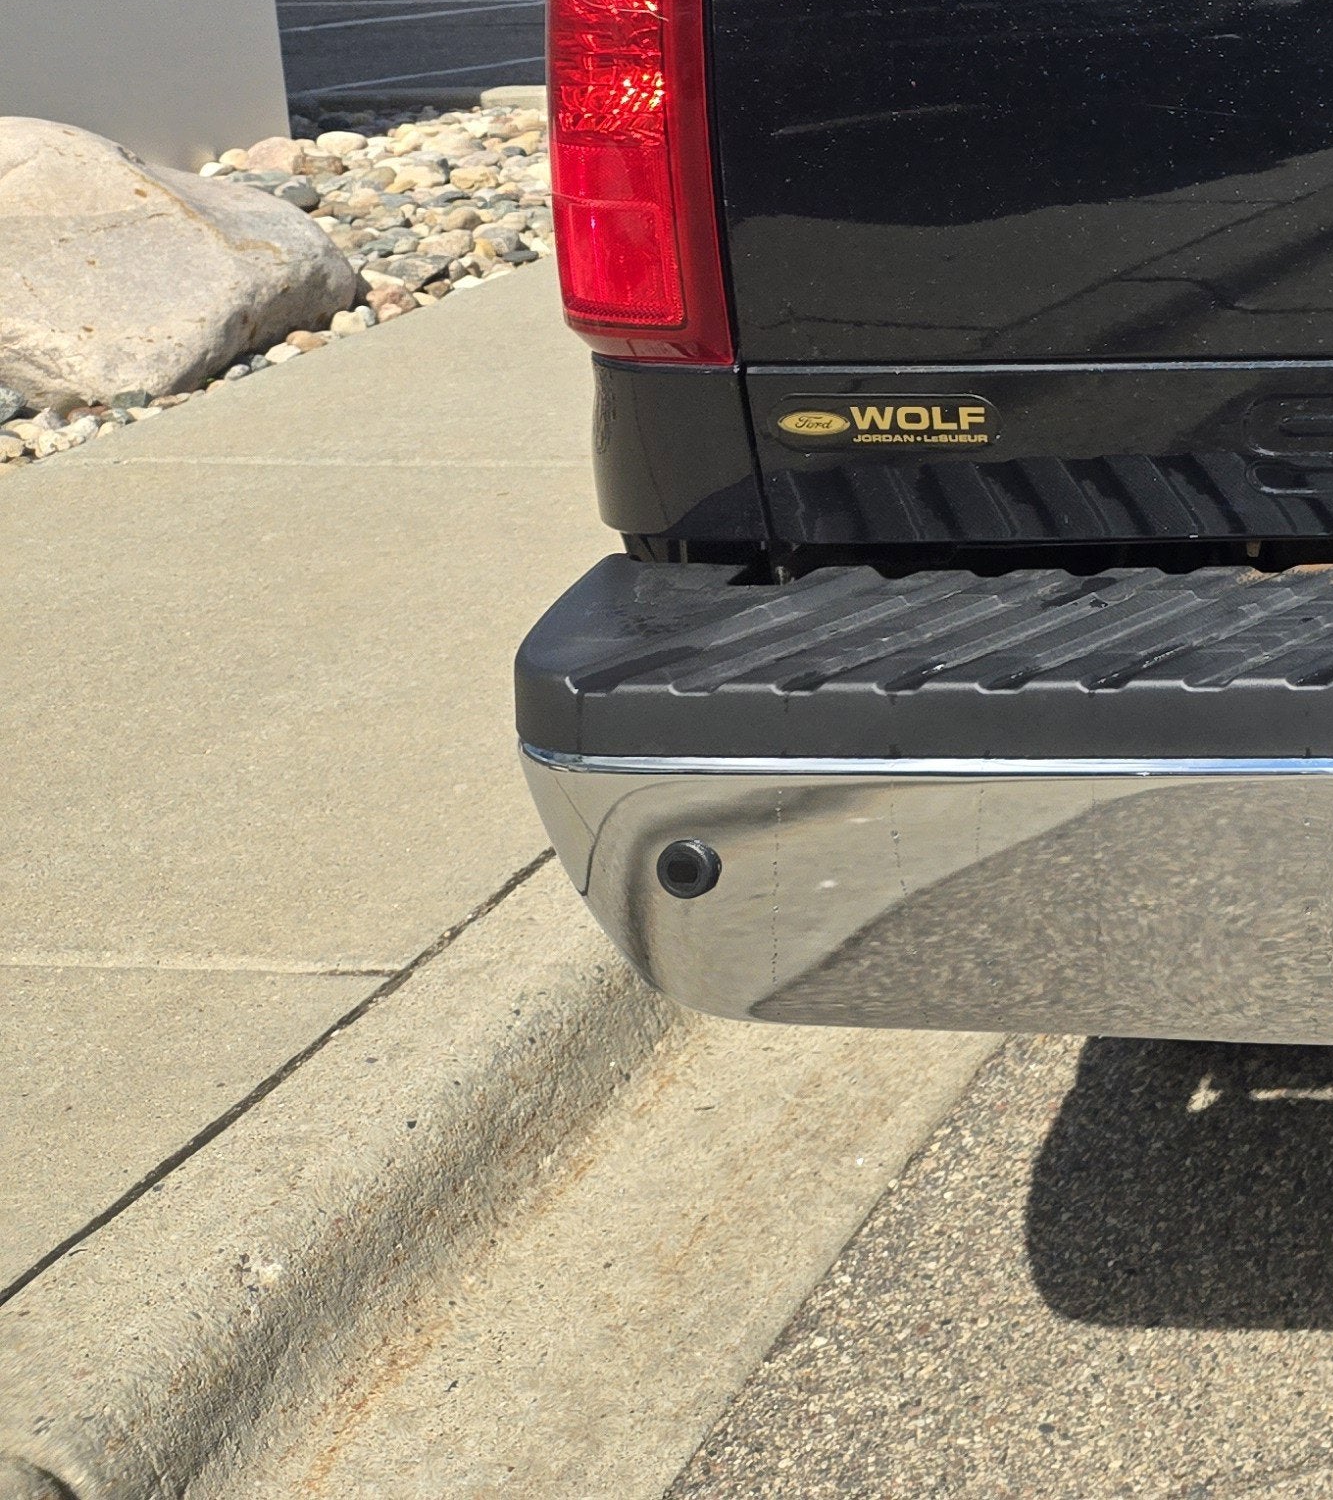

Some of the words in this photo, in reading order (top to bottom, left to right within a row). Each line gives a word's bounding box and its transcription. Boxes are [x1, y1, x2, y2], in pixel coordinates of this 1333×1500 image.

[794, 415, 832, 430] Ford
[850, 406, 985, 430] WOLF
[853, 434, 914, 443] JORDAN
